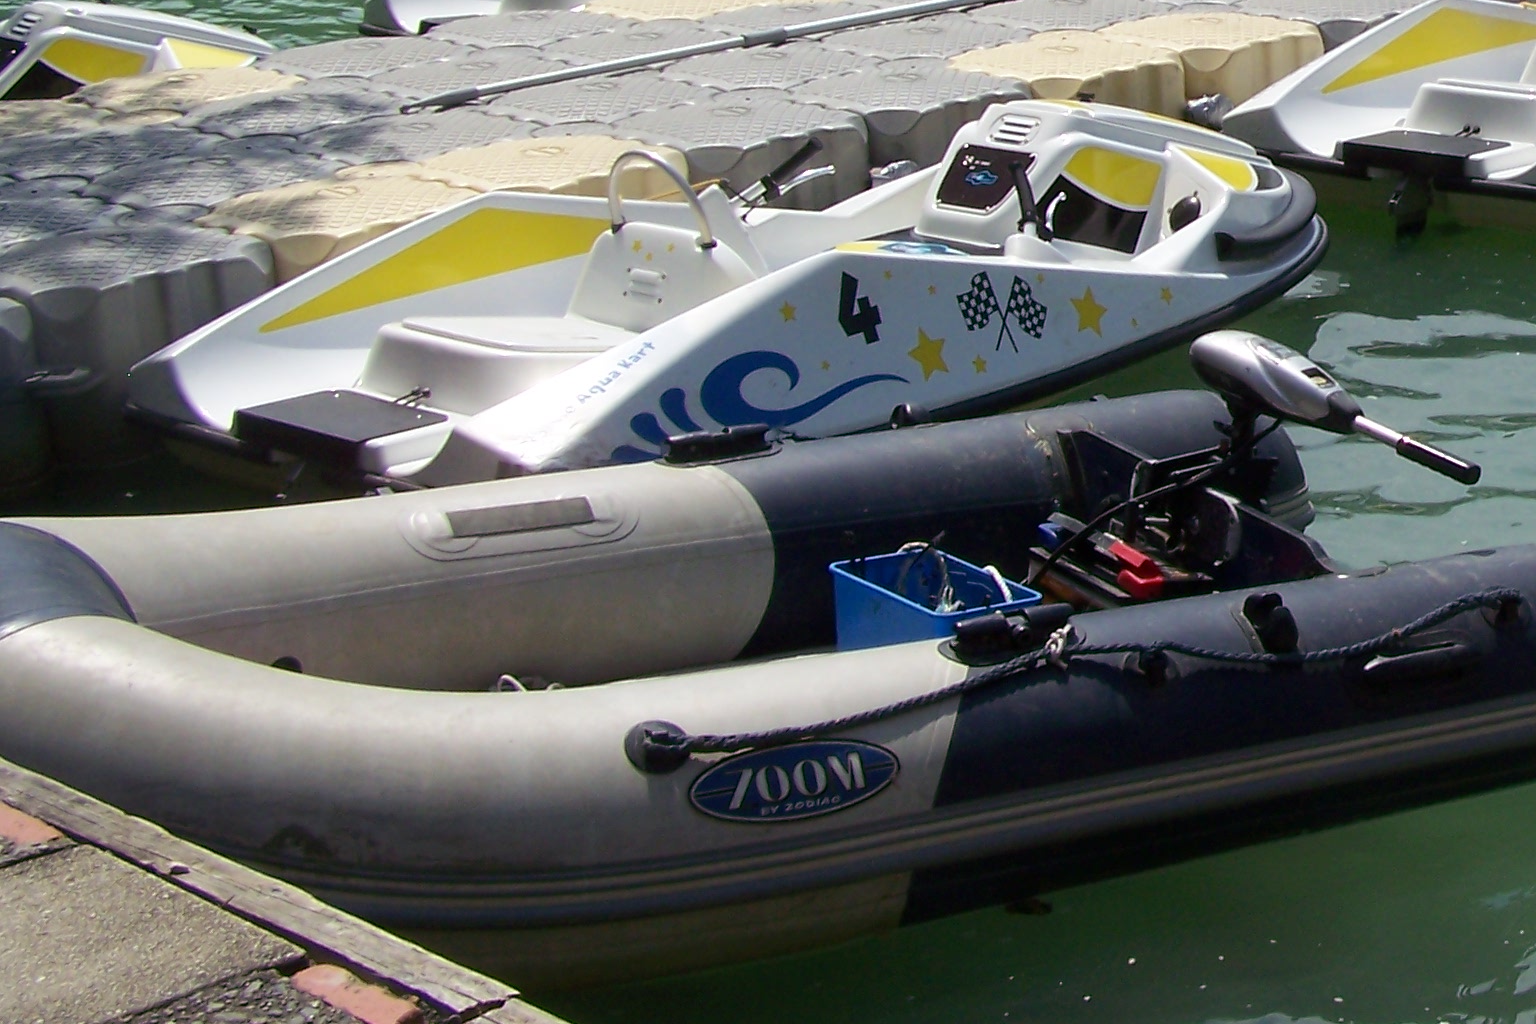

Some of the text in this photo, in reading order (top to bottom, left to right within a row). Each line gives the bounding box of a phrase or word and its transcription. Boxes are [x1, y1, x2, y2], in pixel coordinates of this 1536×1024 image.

[838, 270, 883, 345] 4
[577, 341, 655, 404] Aqua Kart
[784, 794, 842, 813] ZODIAC
